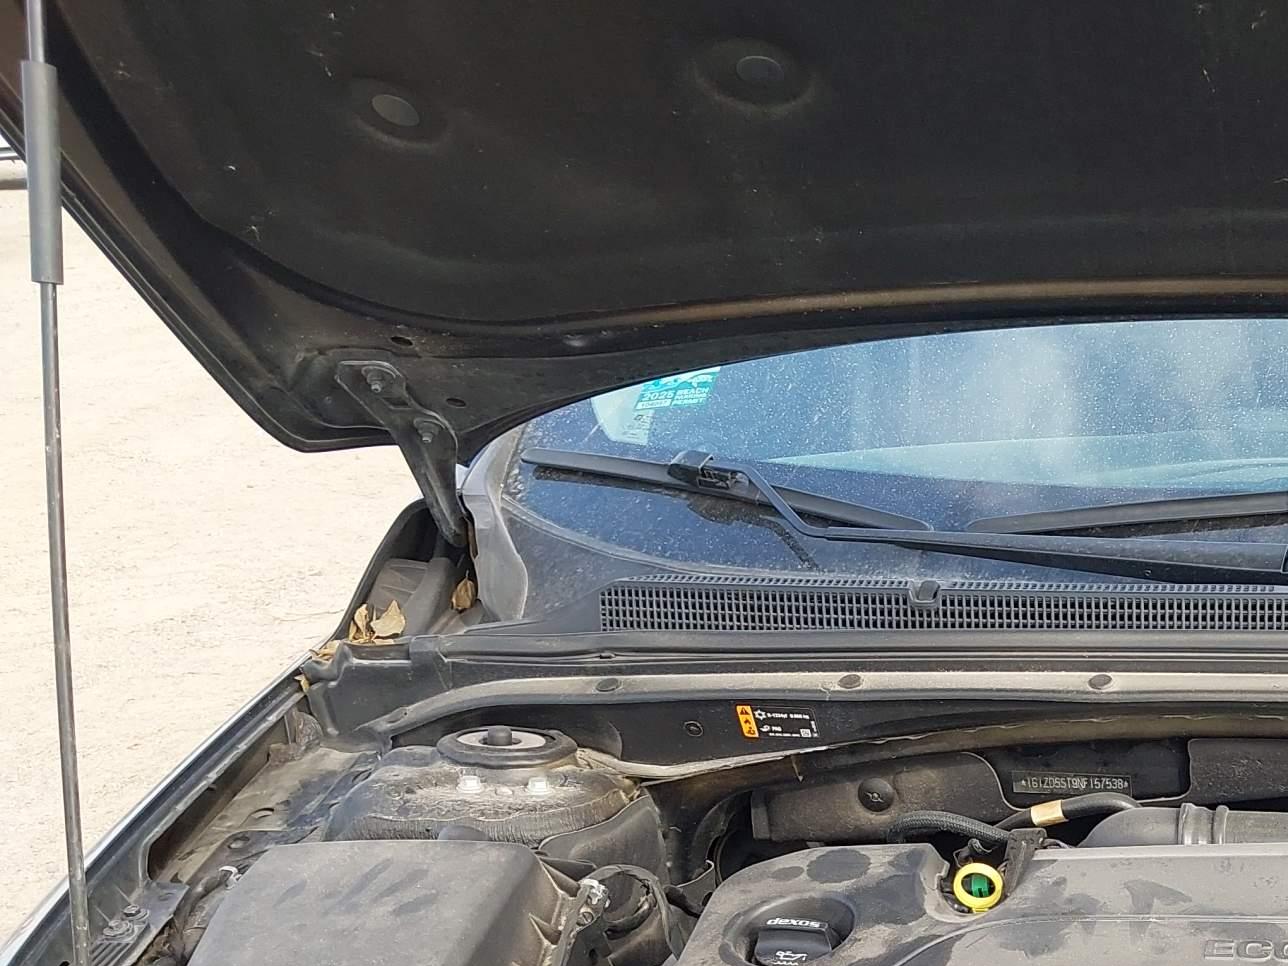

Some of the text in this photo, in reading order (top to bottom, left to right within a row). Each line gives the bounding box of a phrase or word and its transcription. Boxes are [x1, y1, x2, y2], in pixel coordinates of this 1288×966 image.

[642, 390, 675, 401] 2025
[676, 387, 710, 396] BEACH
[766, 917, 820, 928] dexos
